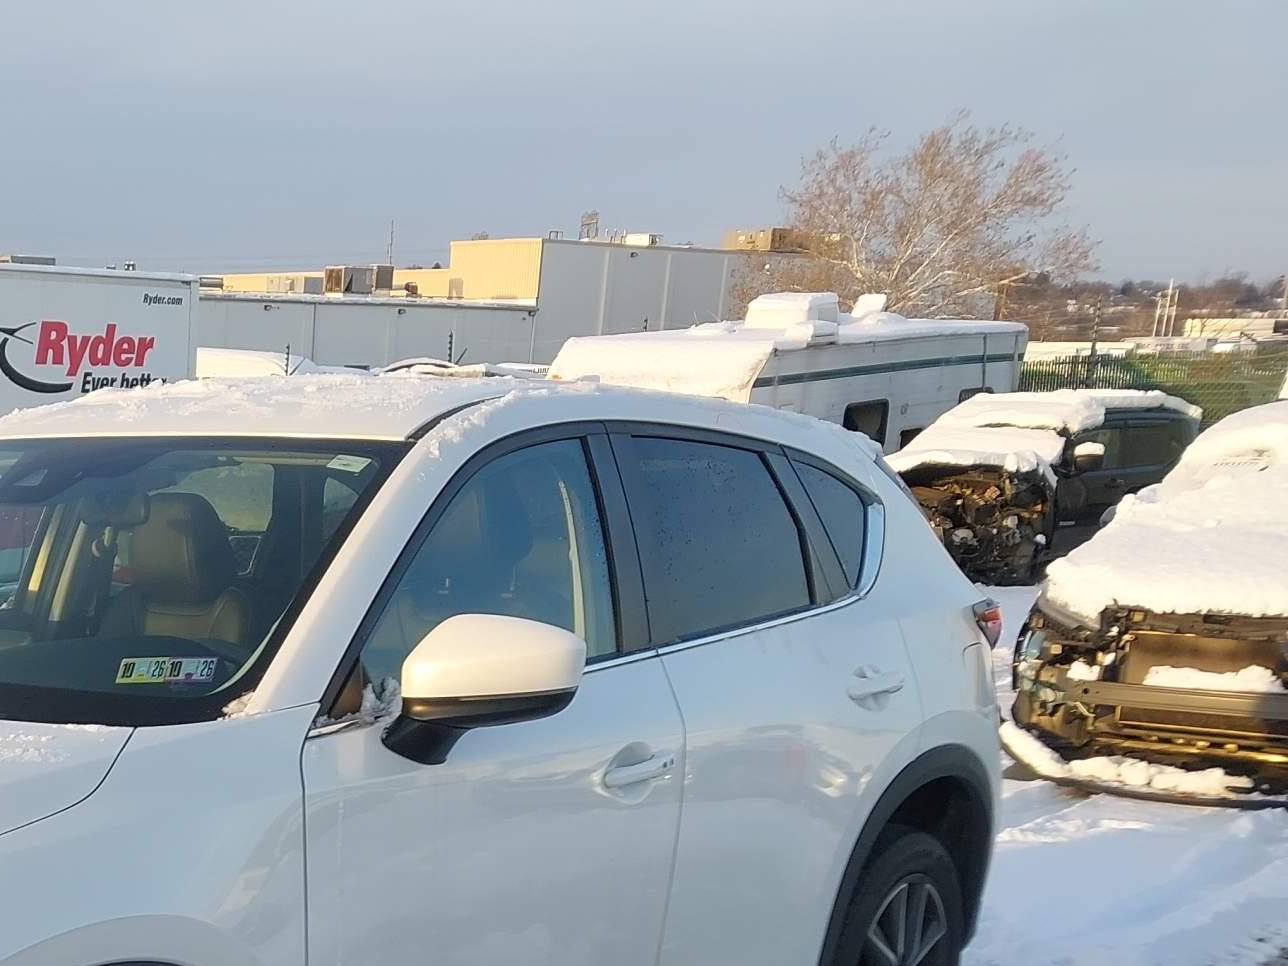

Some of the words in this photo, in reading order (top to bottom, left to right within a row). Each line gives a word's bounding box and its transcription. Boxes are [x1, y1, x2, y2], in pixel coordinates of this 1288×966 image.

[142, 293, 184, 306] Ryder.com
[35, 320, 155, 377] Ryder
[81, 371, 117, 394] Ever
[121, 662, 136, 679] 10
[168, 660, 182, 677] 10
